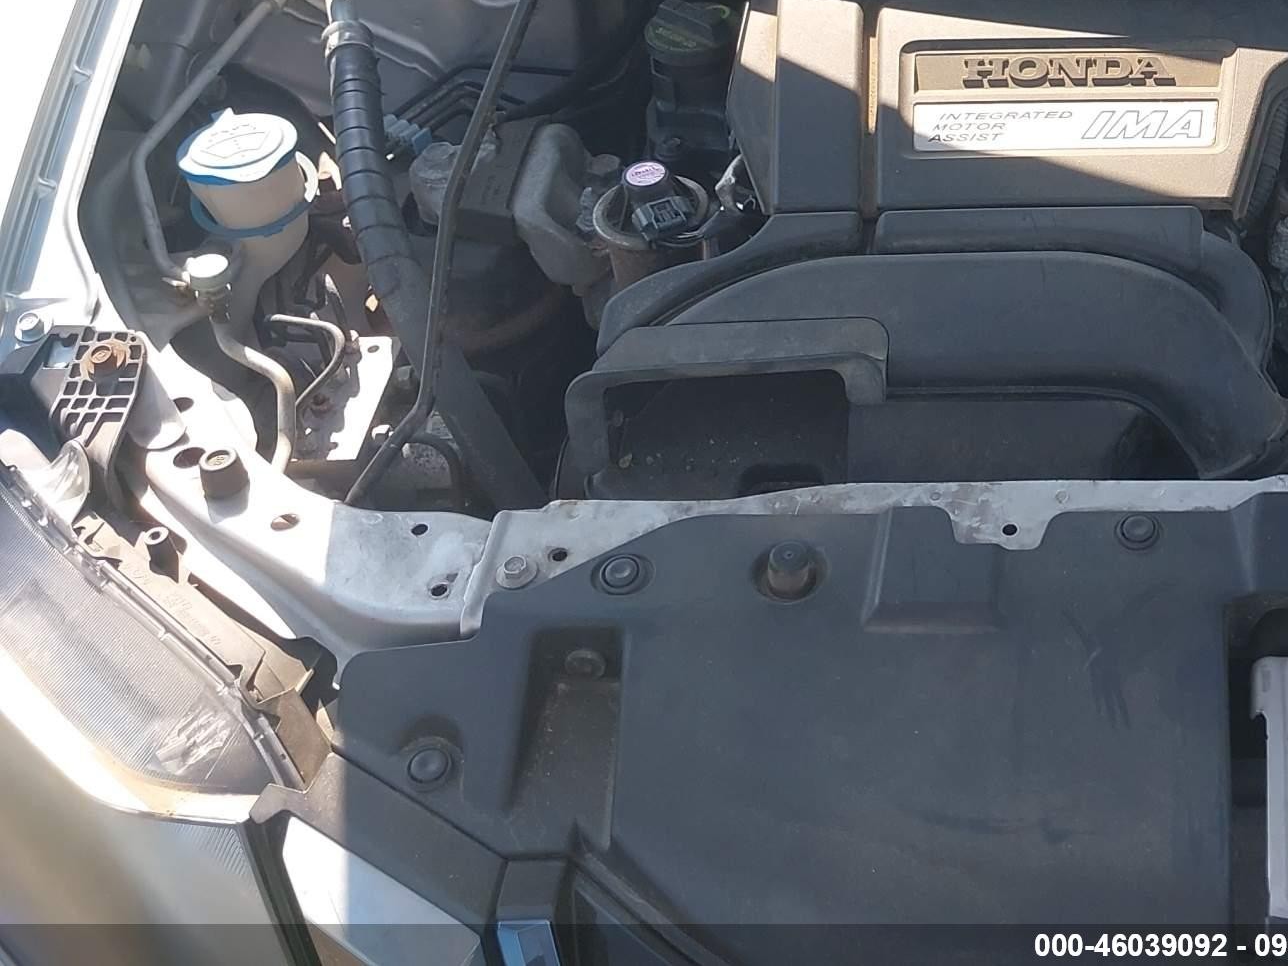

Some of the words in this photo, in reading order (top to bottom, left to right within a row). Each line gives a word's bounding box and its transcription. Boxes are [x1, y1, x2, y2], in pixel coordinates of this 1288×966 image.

[962, 56, 1177, 87] HONDA
[938, 110, 1073, 120] INTEGRATED
[933, 122, 1007, 132] MOTOR
[1081, 109, 1204, 140] IMA
[928, 133, 1005, 143] ASSIST
